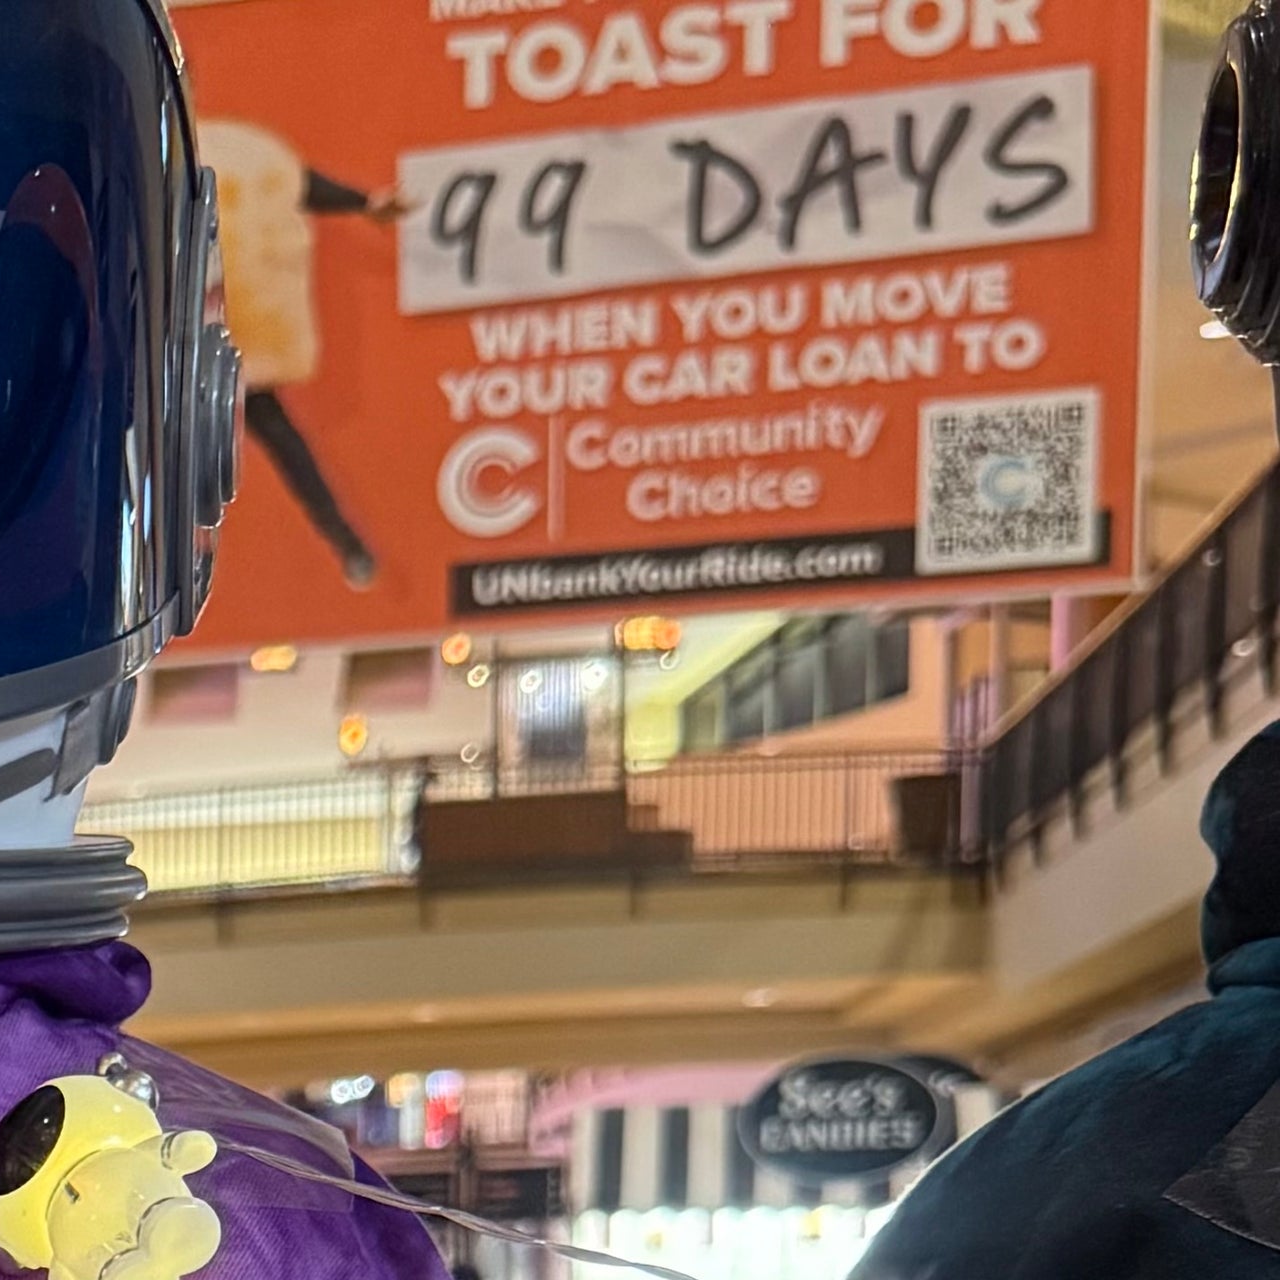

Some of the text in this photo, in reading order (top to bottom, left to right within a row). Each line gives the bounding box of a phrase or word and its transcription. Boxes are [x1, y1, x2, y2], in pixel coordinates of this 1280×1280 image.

[447, 0, 1040, 109] TOAST FOR
[429, 95, 1068, 284] 99 DAYS
[470, 263, 1013, 363] WHEN YOU MOVE
[439, 319, 1046, 422] YOUR CAR LOAN TO
[566, 401, 886, 470] Community
[627, 465, 822, 521] Choice
[780, 1073, 907, 1120] See's
